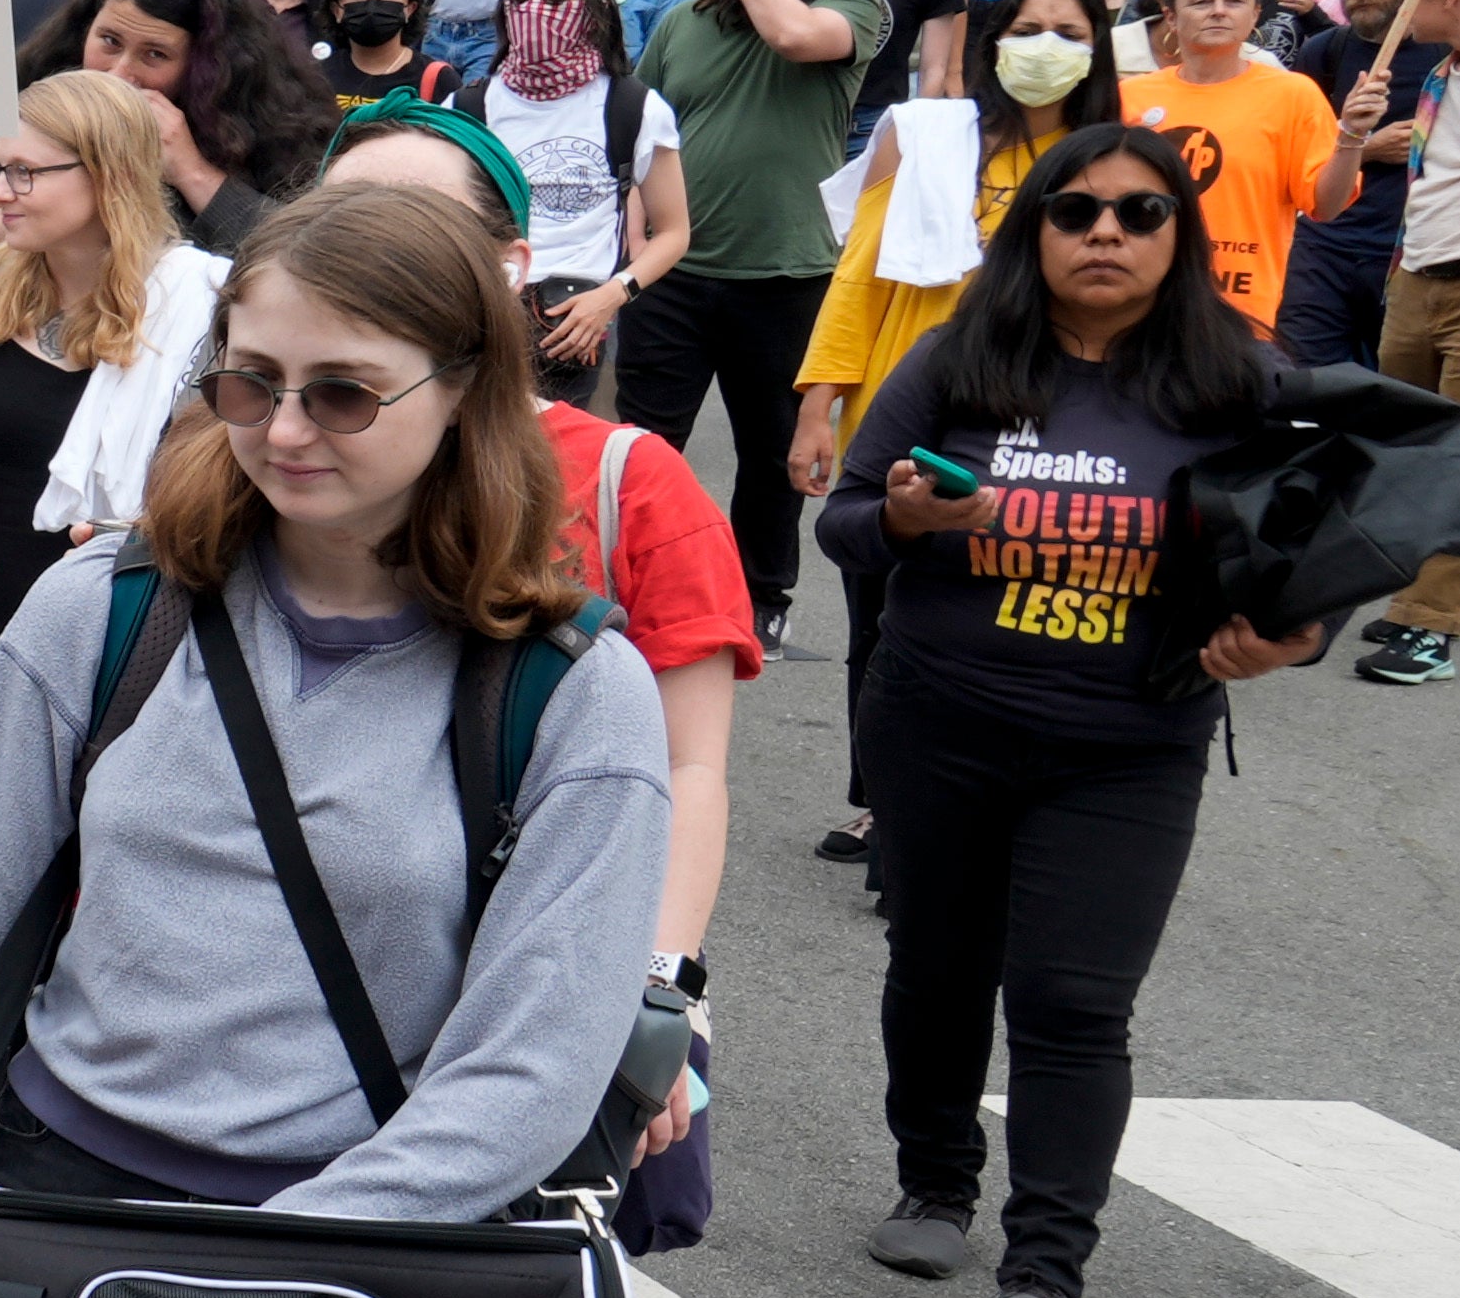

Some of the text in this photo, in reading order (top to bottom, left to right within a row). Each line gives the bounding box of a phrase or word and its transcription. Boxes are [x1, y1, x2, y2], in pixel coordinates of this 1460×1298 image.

[990, 445, 1126, 485] Speaks:
[969, 535, 1163, 596] NOTHIN
[995, 581, 1132, 644] LESS!
